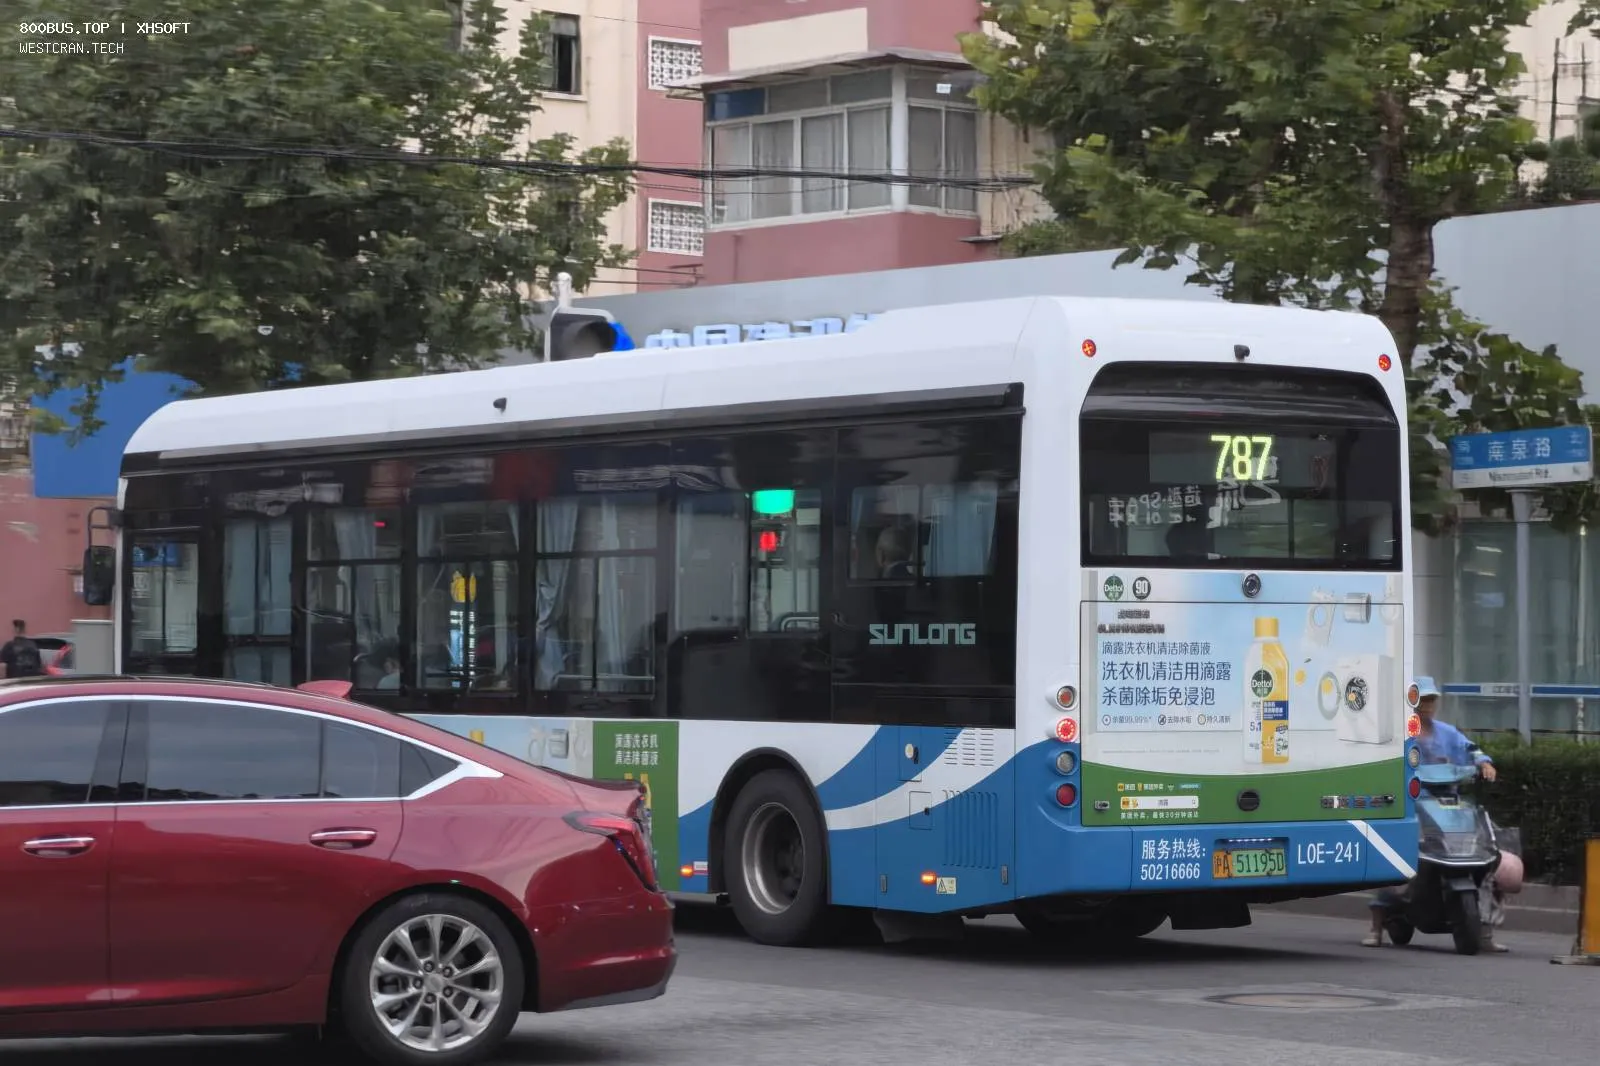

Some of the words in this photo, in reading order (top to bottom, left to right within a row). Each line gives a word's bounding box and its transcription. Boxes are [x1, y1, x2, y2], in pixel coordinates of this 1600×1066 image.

[1211, 435, 1272, 480] 787
[1104, 584, 1123, 592] Dettol
[1135, 580, 1148, 594] 90
[869, 623, 976, 645] SUNLONG
[1102, 641, 1211, 656] 滴露洗衣机清洁除菌液
[1102, 661, 1232, 681] 洗衣机清洁用滴露
[1251, 680, 1272, 688] Dettol
[1102, 686, 1215, 706] 杀菌除垢免浸泡
[1140, 863, 1200, 880] 50216666
